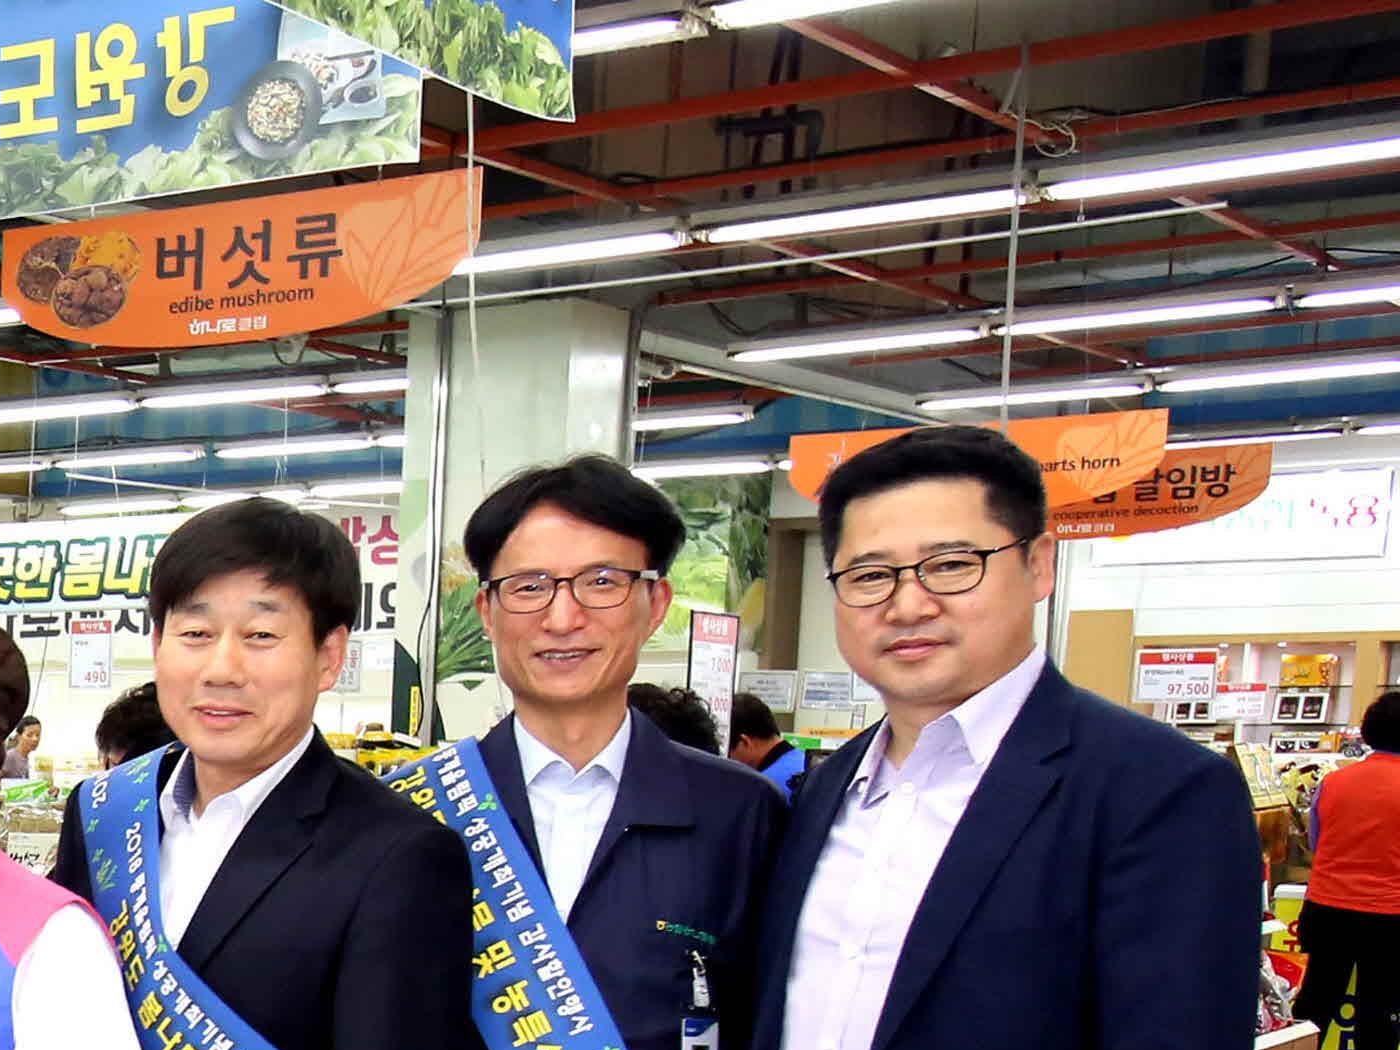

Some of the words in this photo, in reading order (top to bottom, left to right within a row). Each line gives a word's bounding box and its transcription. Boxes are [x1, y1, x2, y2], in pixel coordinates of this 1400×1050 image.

[156, 213, 343, 291] 버섯류
[169, 297, 215, 315] edibe
[219, 286, 315, 309] mushroom
[1080, 455, 1122, 472] horn
[1133, 502, 1200, 518] decoction
[62, 534, 157, 603] 봄나
[84, 670, 107, 684] 490
[1166, 682, 1210, 697] 97,500
[125, 821, 144, 874] 2018
[108, 899, 146, 993] 강원도
[464, 816, 534, 923] 성공개최기념
[518, 922, 593, 1038] 감사할인행사
[471, 938, 517, 978] 및
